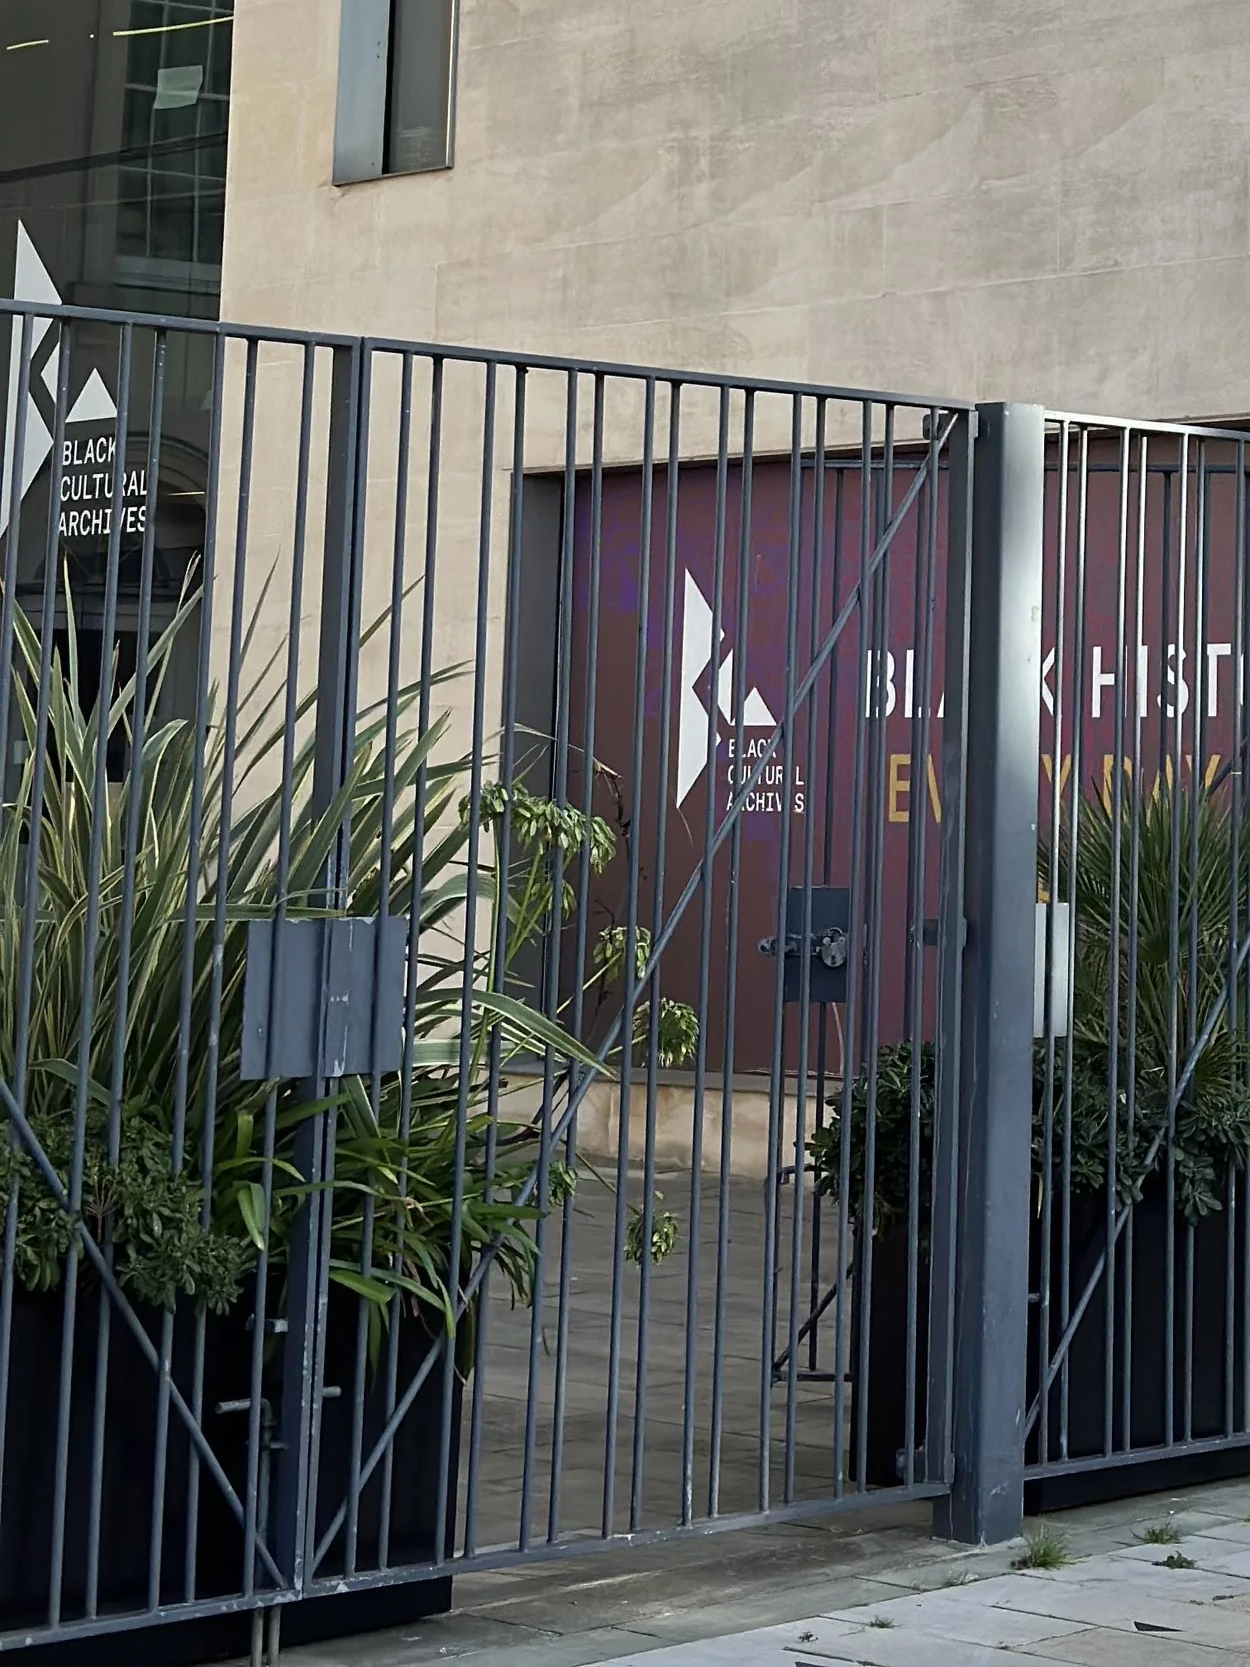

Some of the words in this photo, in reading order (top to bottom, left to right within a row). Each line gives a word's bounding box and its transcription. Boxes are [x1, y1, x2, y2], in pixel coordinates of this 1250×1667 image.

[62, 437, 117, 466] BLACK
[60, 470, 148, 502] CULTURAL
[865, 646, 1062, 719] BLK
[728, 739, 777, 758] BAC
[727, 765, 805, 786] CUURL
[888, 753, 1073, 824] EVY
[726, 792, 805, 813] ACHIVS
